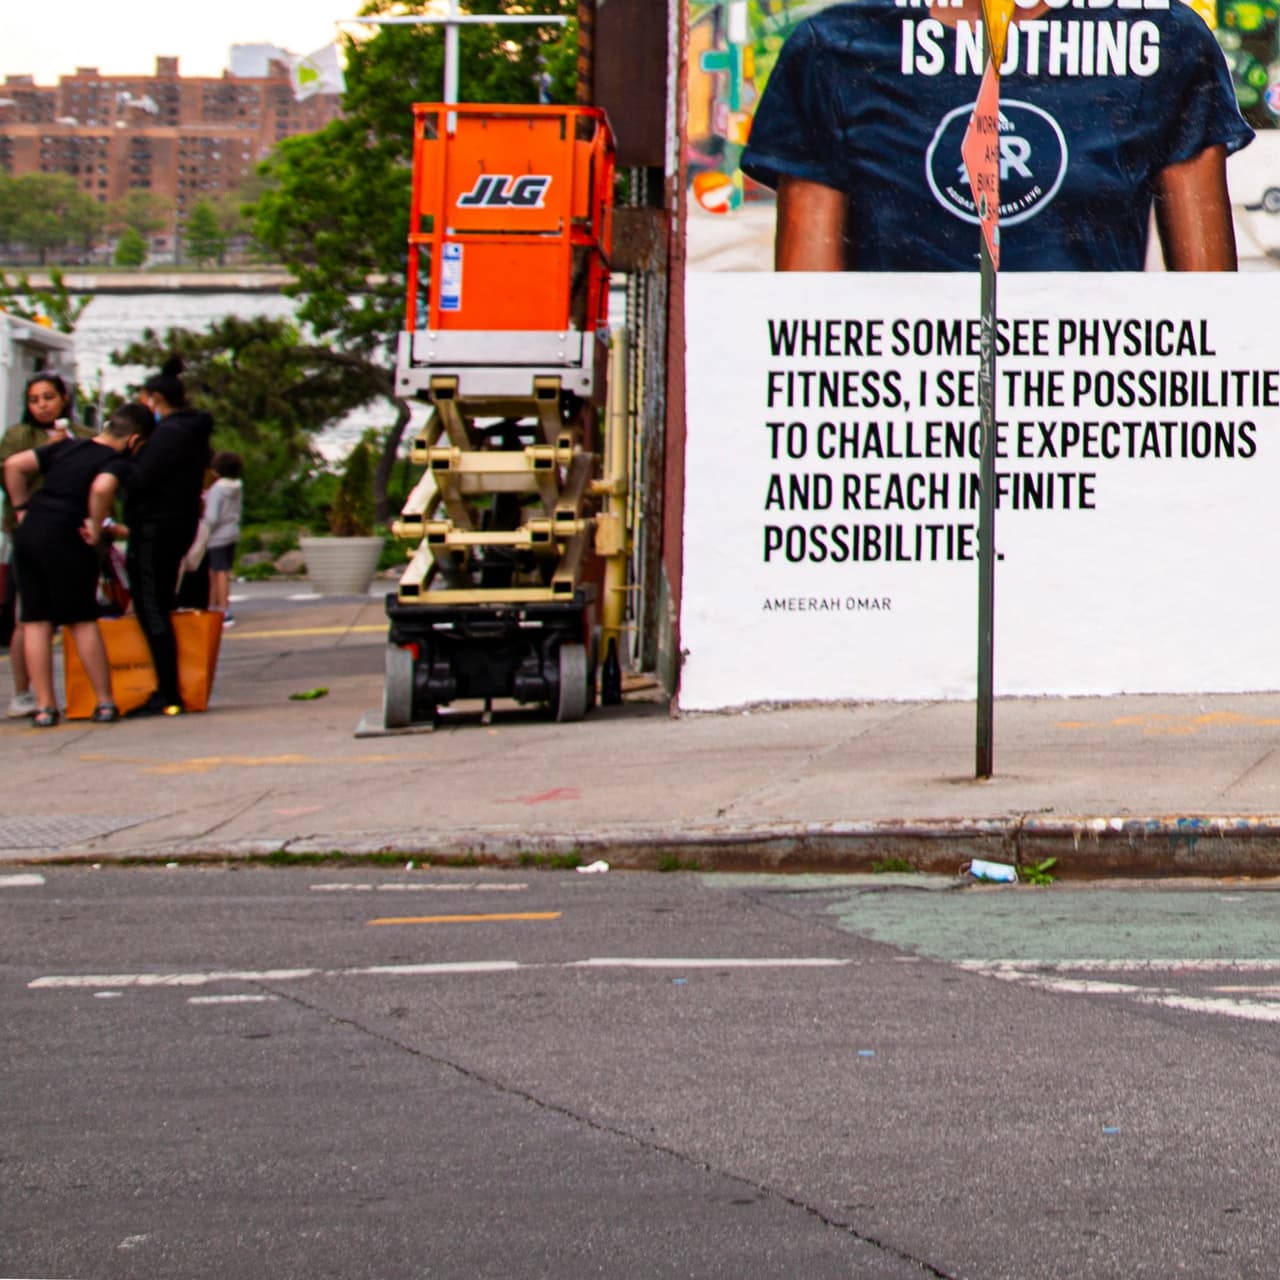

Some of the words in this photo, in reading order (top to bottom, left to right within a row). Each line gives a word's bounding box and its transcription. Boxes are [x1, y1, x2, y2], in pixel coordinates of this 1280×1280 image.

[901, 19, 945, 76] IS
[457, 175, 551, 207] JLG
[768, 320, 883, 357] WHERE
[891, 320, 981, 357] SOME
[995, 320, 1048, 357] SEE
[1058, 320, 1216, 357] PHYSICAL
[767, 371, 910, 411] FITNESS,
[919, 371, 927, 407] I
[936, 371, 983, 407] SE
[1003, 371, 1064, 407] THE
[766, 422, 808, 459] TO
[1017, 422, 1257, 459] EXPECTATIONS
[765, 473, 833, 511] AND
[843, 473, 948, 511] REACH
[764, 524, 1005, 562] POSSIBILITIE.
[763, 597, 841, 611] AMEERAH
[845, 597, 892, 611] OMAR
